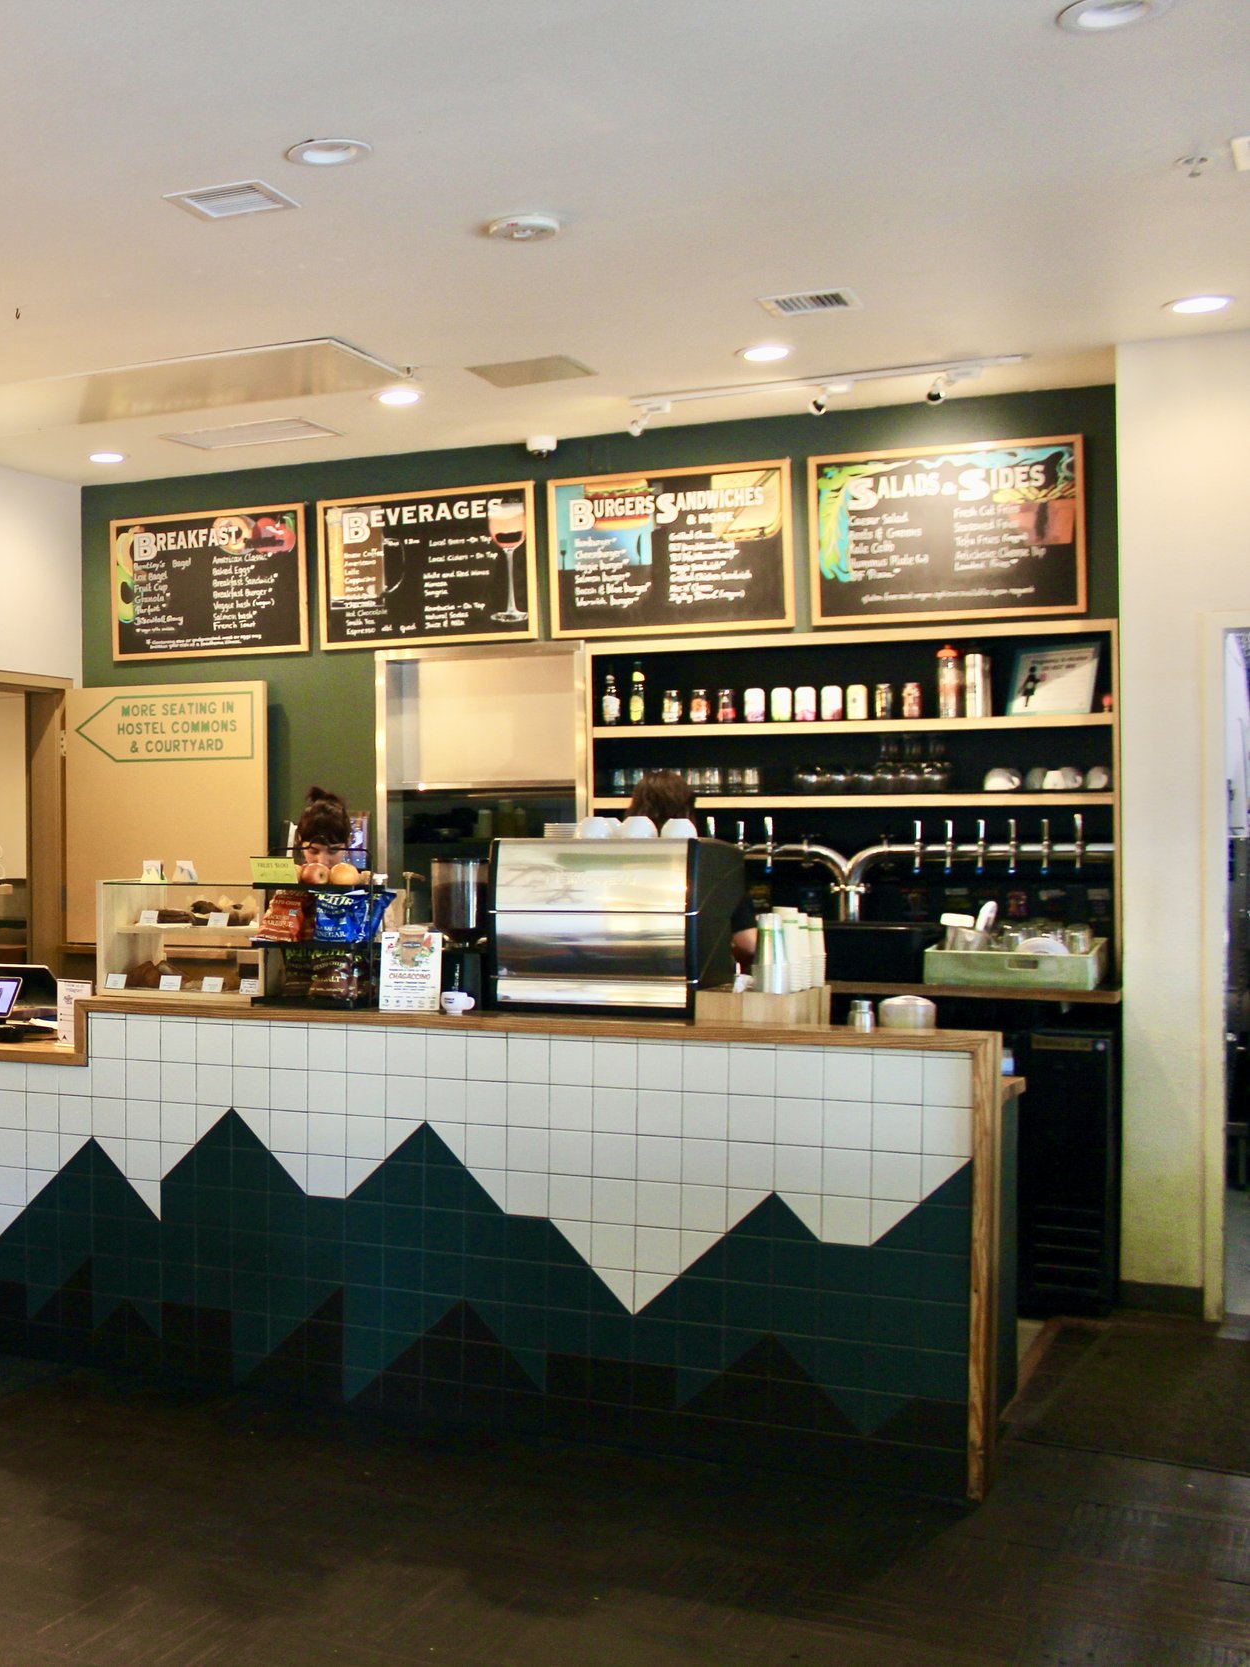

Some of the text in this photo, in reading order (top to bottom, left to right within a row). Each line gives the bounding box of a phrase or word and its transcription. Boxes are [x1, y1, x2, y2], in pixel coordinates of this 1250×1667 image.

[848, 472, 940, 510] SALADS
[958, 465, 1046, 501] SIDES
[569, 486, 764, 531] BURGERS SANDWICHES
[342, 498, 503, 544] BEVERAGES
[686, 511, 734, 525] & MORE
[882, 512, 908, 525] Salad
[134, 526, 238, 561] BREAKFAST
[429, 539, 446, 547] Local
[428, 555, 445, 563] Local
[213, 621, 237, 631] French
[121, 702, 234, 717] MORE SEATING IN
[117, 720, 237, 735] HOSTEL COMMONS
[130, 738, 224, 753] & COURTYARD
